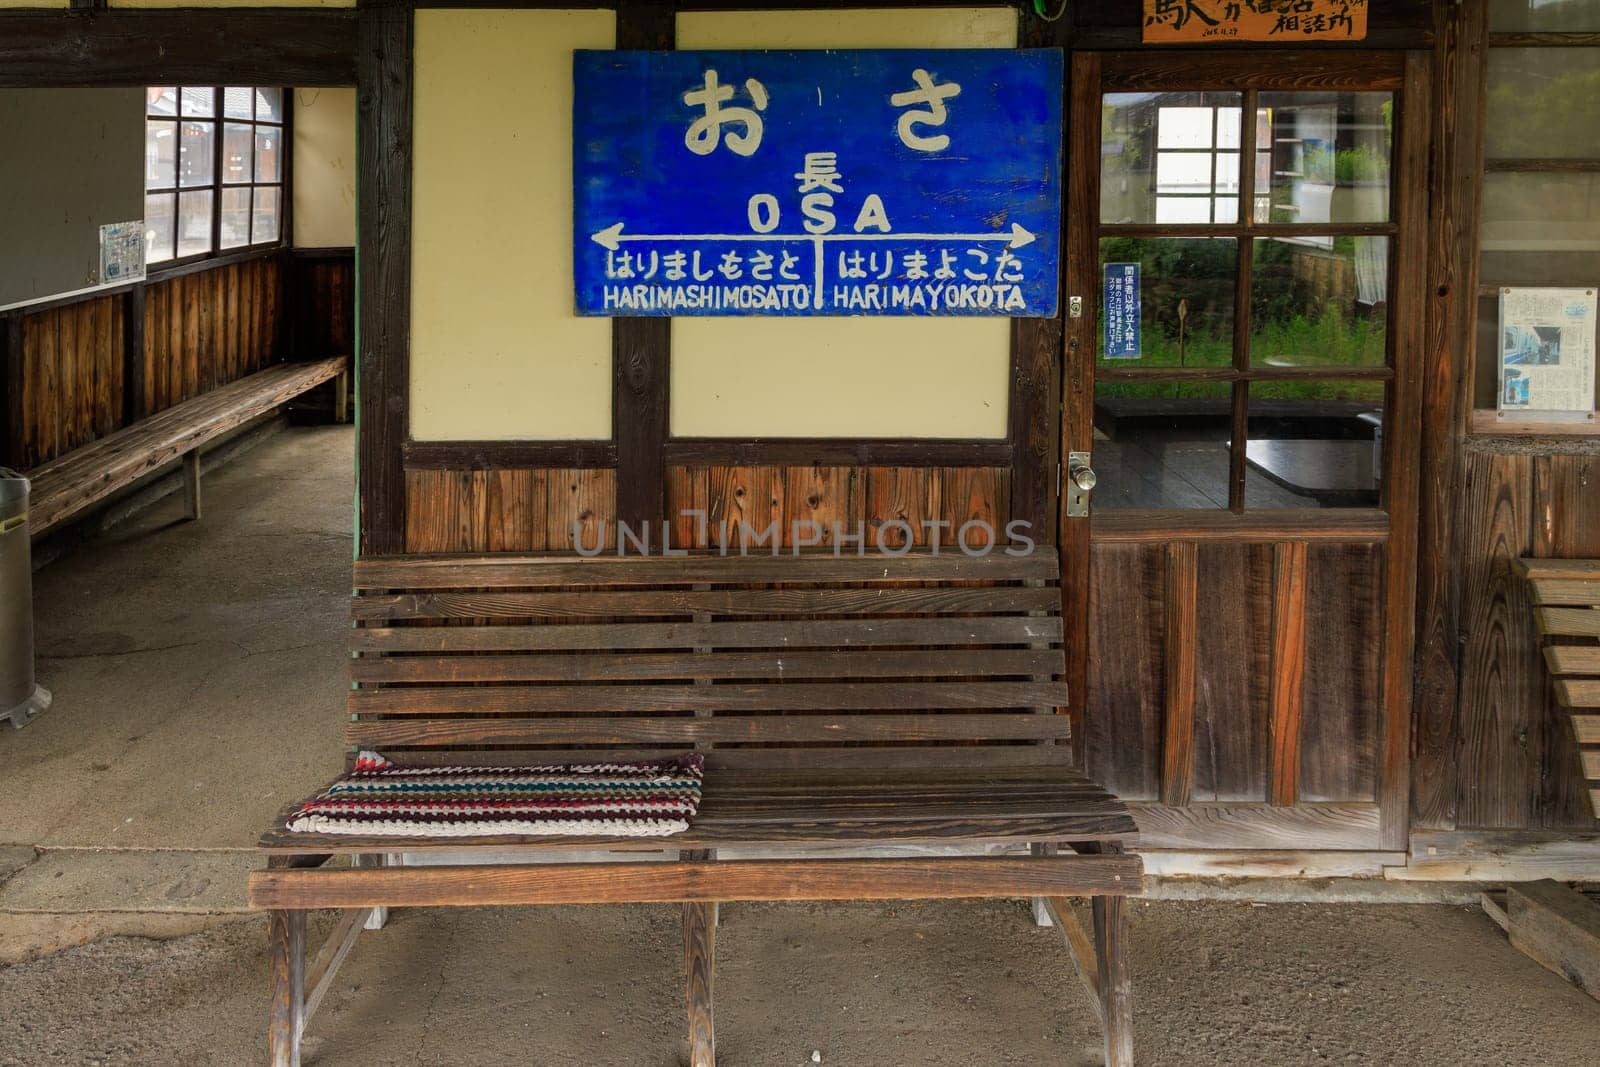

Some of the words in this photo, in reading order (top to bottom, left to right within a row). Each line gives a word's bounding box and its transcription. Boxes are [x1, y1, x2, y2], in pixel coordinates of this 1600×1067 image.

[1269, 7, 1353, 35] 相談所
[795, 152, 843, 193] 長
[747, 194, 892, 234] OSA
[605, 250, 801, 280] はりましもさと
[838, 249, 1025, 281] はりまよこた
[603, 284, 809, 309] HARIMASHIMOSATO
[833, 284, 1026, 309] HARIMAYOKOTA
[1124, 266, 1135, 351] 関係者以外立入禁止
